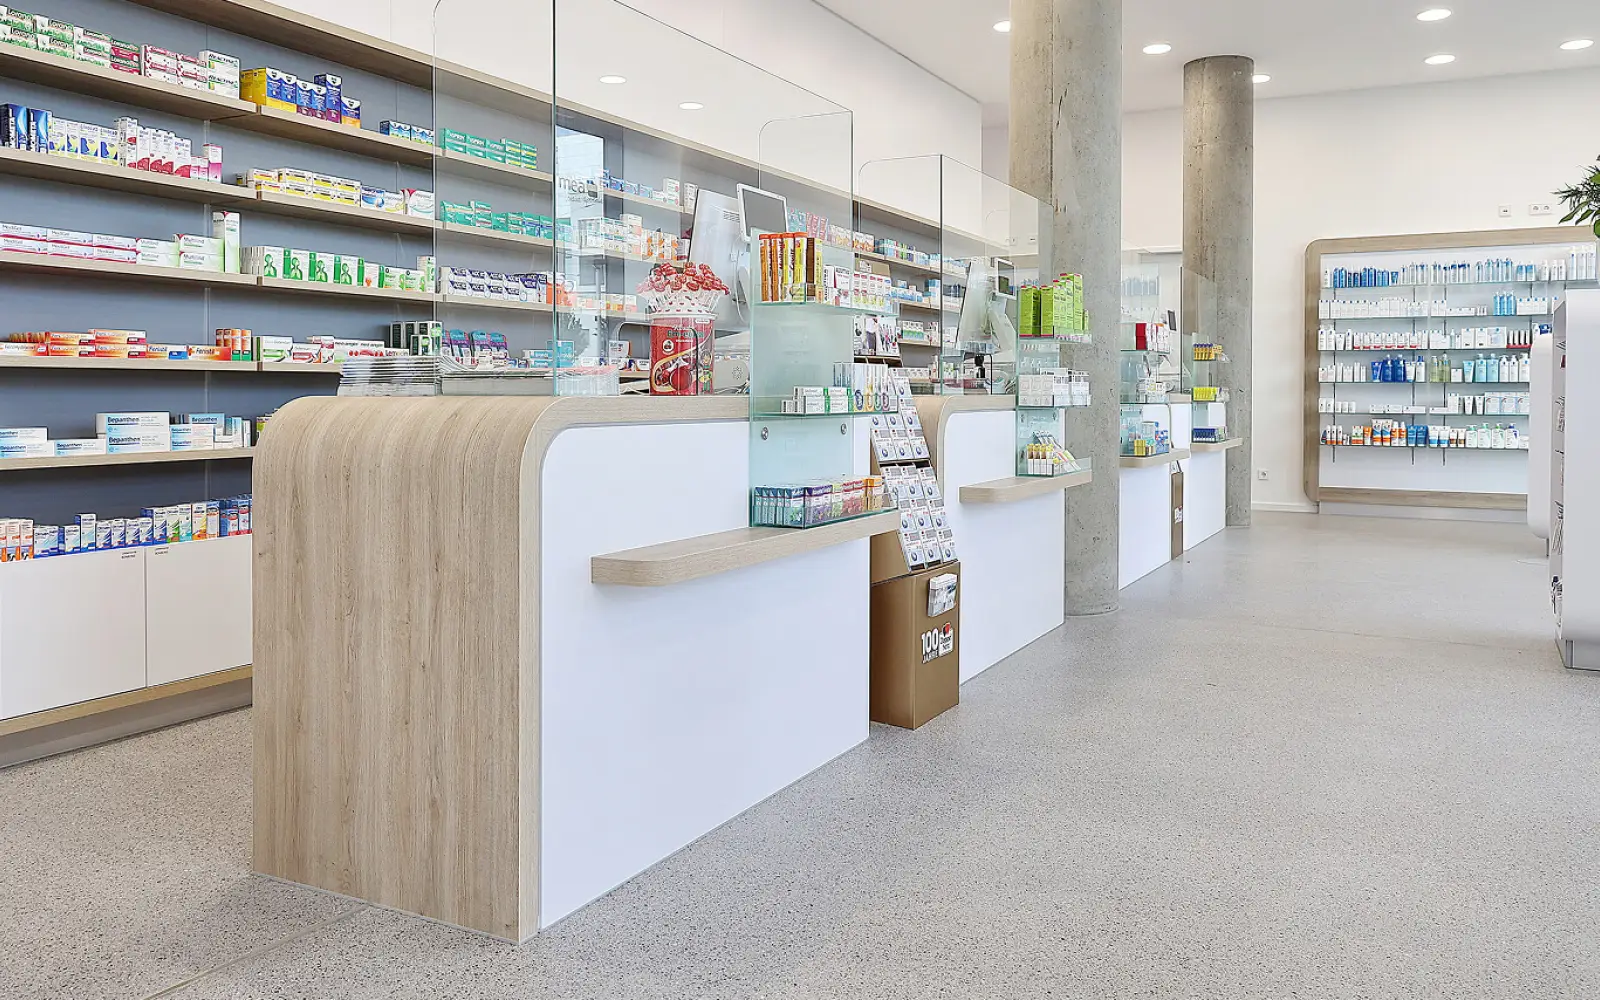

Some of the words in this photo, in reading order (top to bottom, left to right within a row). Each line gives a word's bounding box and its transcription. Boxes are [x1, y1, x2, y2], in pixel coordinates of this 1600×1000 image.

[108, 416, 140, 424] Bepanthen
[109, 436, 141, 444] Bepanthen
[921, 628, 939, 657] 100
